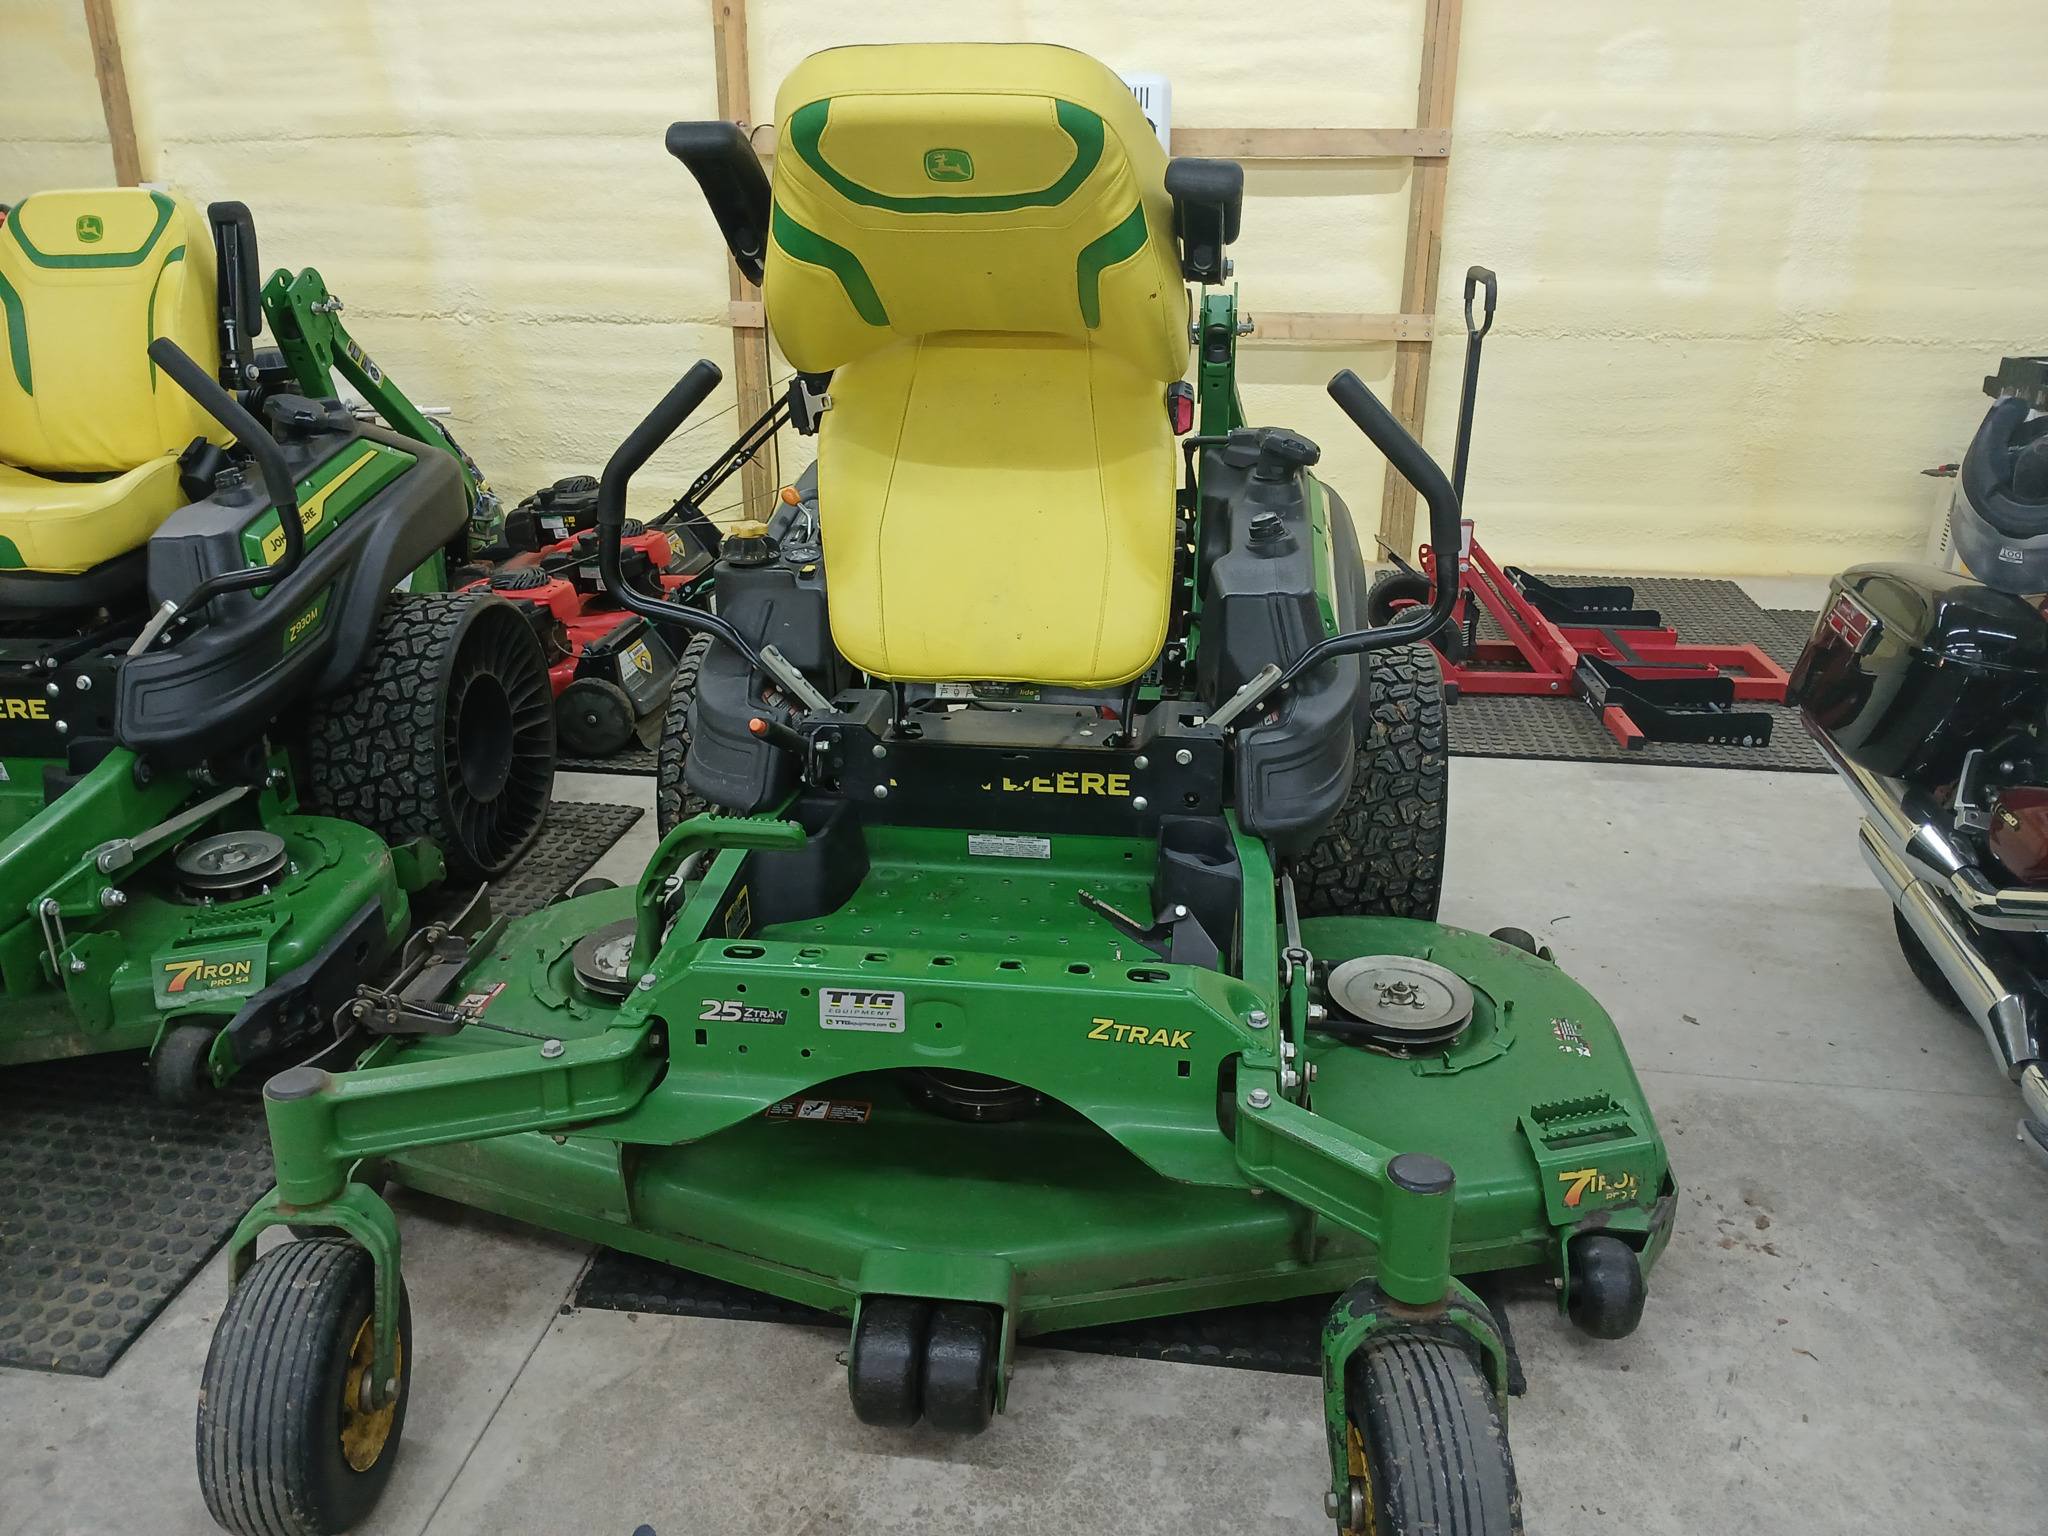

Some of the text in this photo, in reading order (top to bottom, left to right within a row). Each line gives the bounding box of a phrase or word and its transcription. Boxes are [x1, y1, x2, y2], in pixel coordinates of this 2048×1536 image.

[269, 507, 317, 552] JOH ERE
[290, 607, 318, 642] Z930M
[210, 978, 232, 987] PRO
[699, 1000, 784, 1021] 25 ZTRAK
[826, 991, 895, 1009] TTG
[828, 1008, 891, 1016] EQUIPMENT
[1087, 1018, 1193, 1049] ZTRAK
